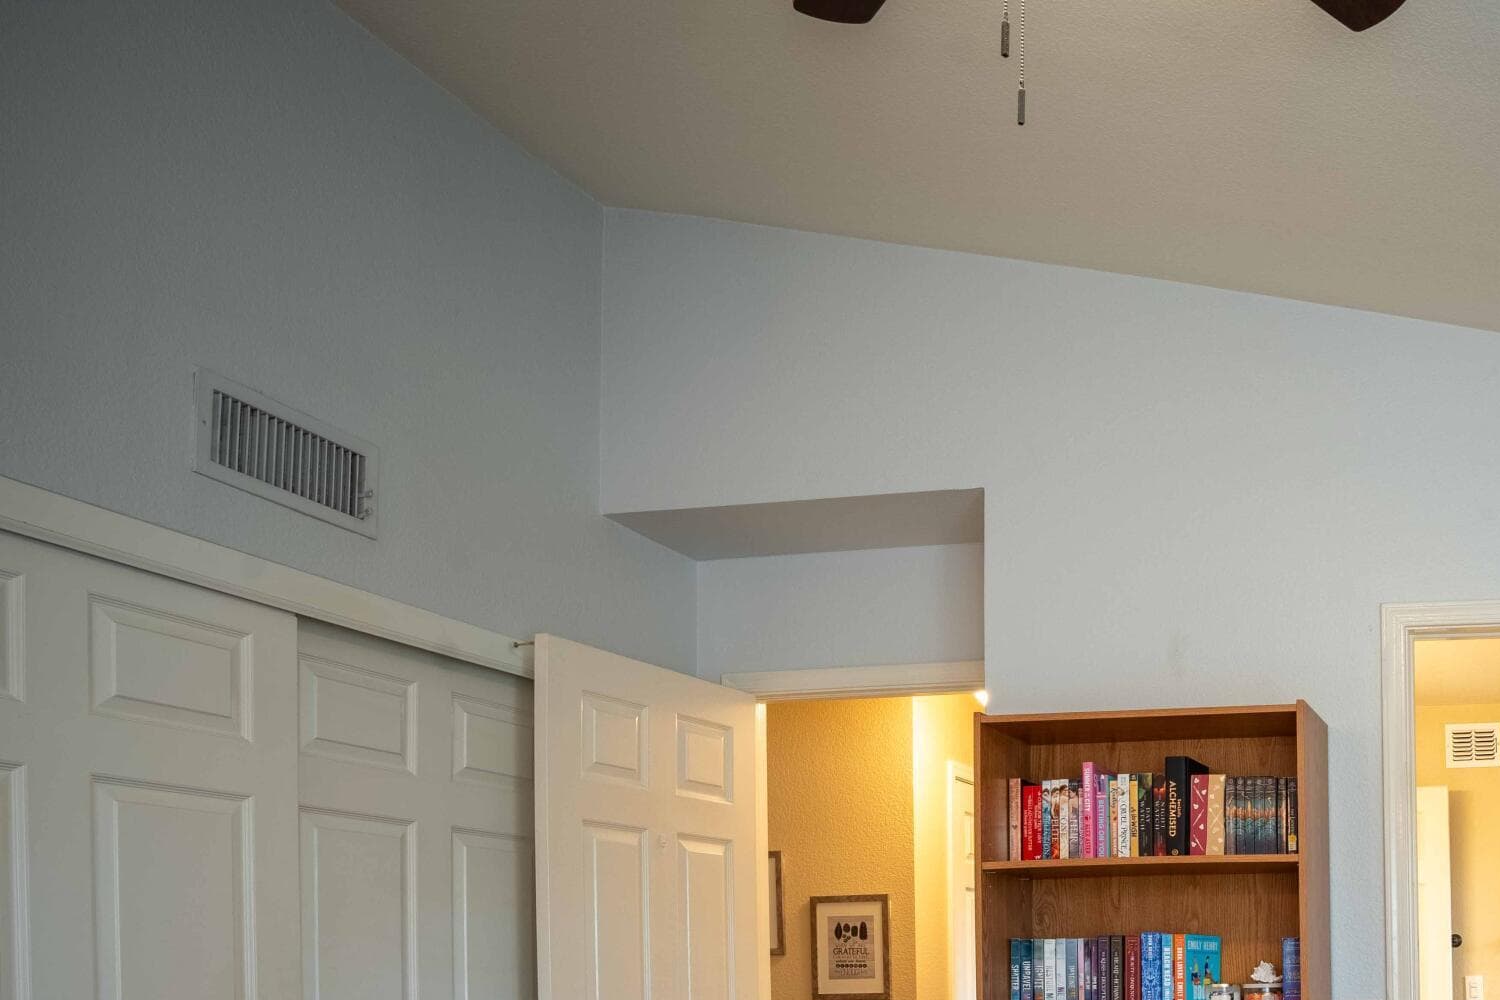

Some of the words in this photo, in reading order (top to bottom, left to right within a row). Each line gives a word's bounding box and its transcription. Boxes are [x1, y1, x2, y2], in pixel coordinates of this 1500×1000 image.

[1168, 780, 1176, 838] ALCHEMISED
[1098, 829, 1105, 841] ON
[832, 947, 869, 955] GRATEFUL
[1187, 939, 1201, 950] EMILY
[1011, 963, 1020, 991] SHATTER
[1022, 961, 1031, 992] UNRAVEL
